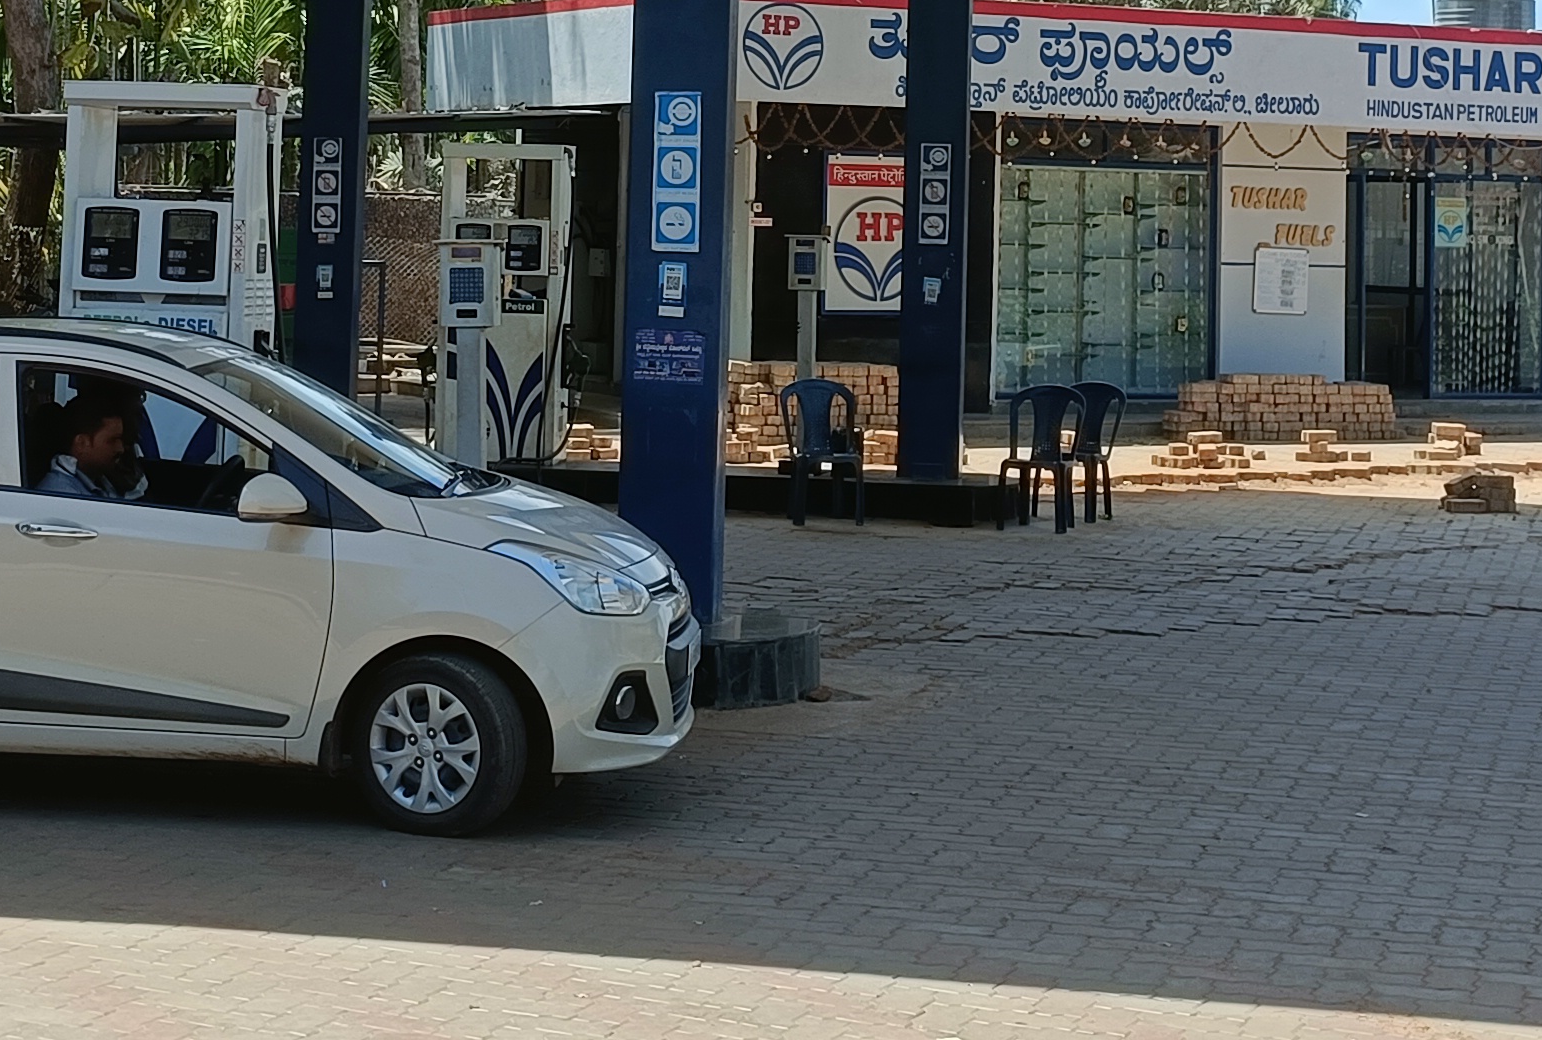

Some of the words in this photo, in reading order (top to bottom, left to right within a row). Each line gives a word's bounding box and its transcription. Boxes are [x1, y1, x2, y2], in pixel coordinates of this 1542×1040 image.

[761, 13, 801, 36] HP
[1366, 99, 1454, 121] HINDUSTAN
[1456, 103, 1538, 124] PETROLEUM
[1230, 185, 1308, 211] TUSHAR
[856, 212, 904, 241] HP
[1274, 223, 1335, 247] FUELS
[505, 302, 535, 311] Petrol
